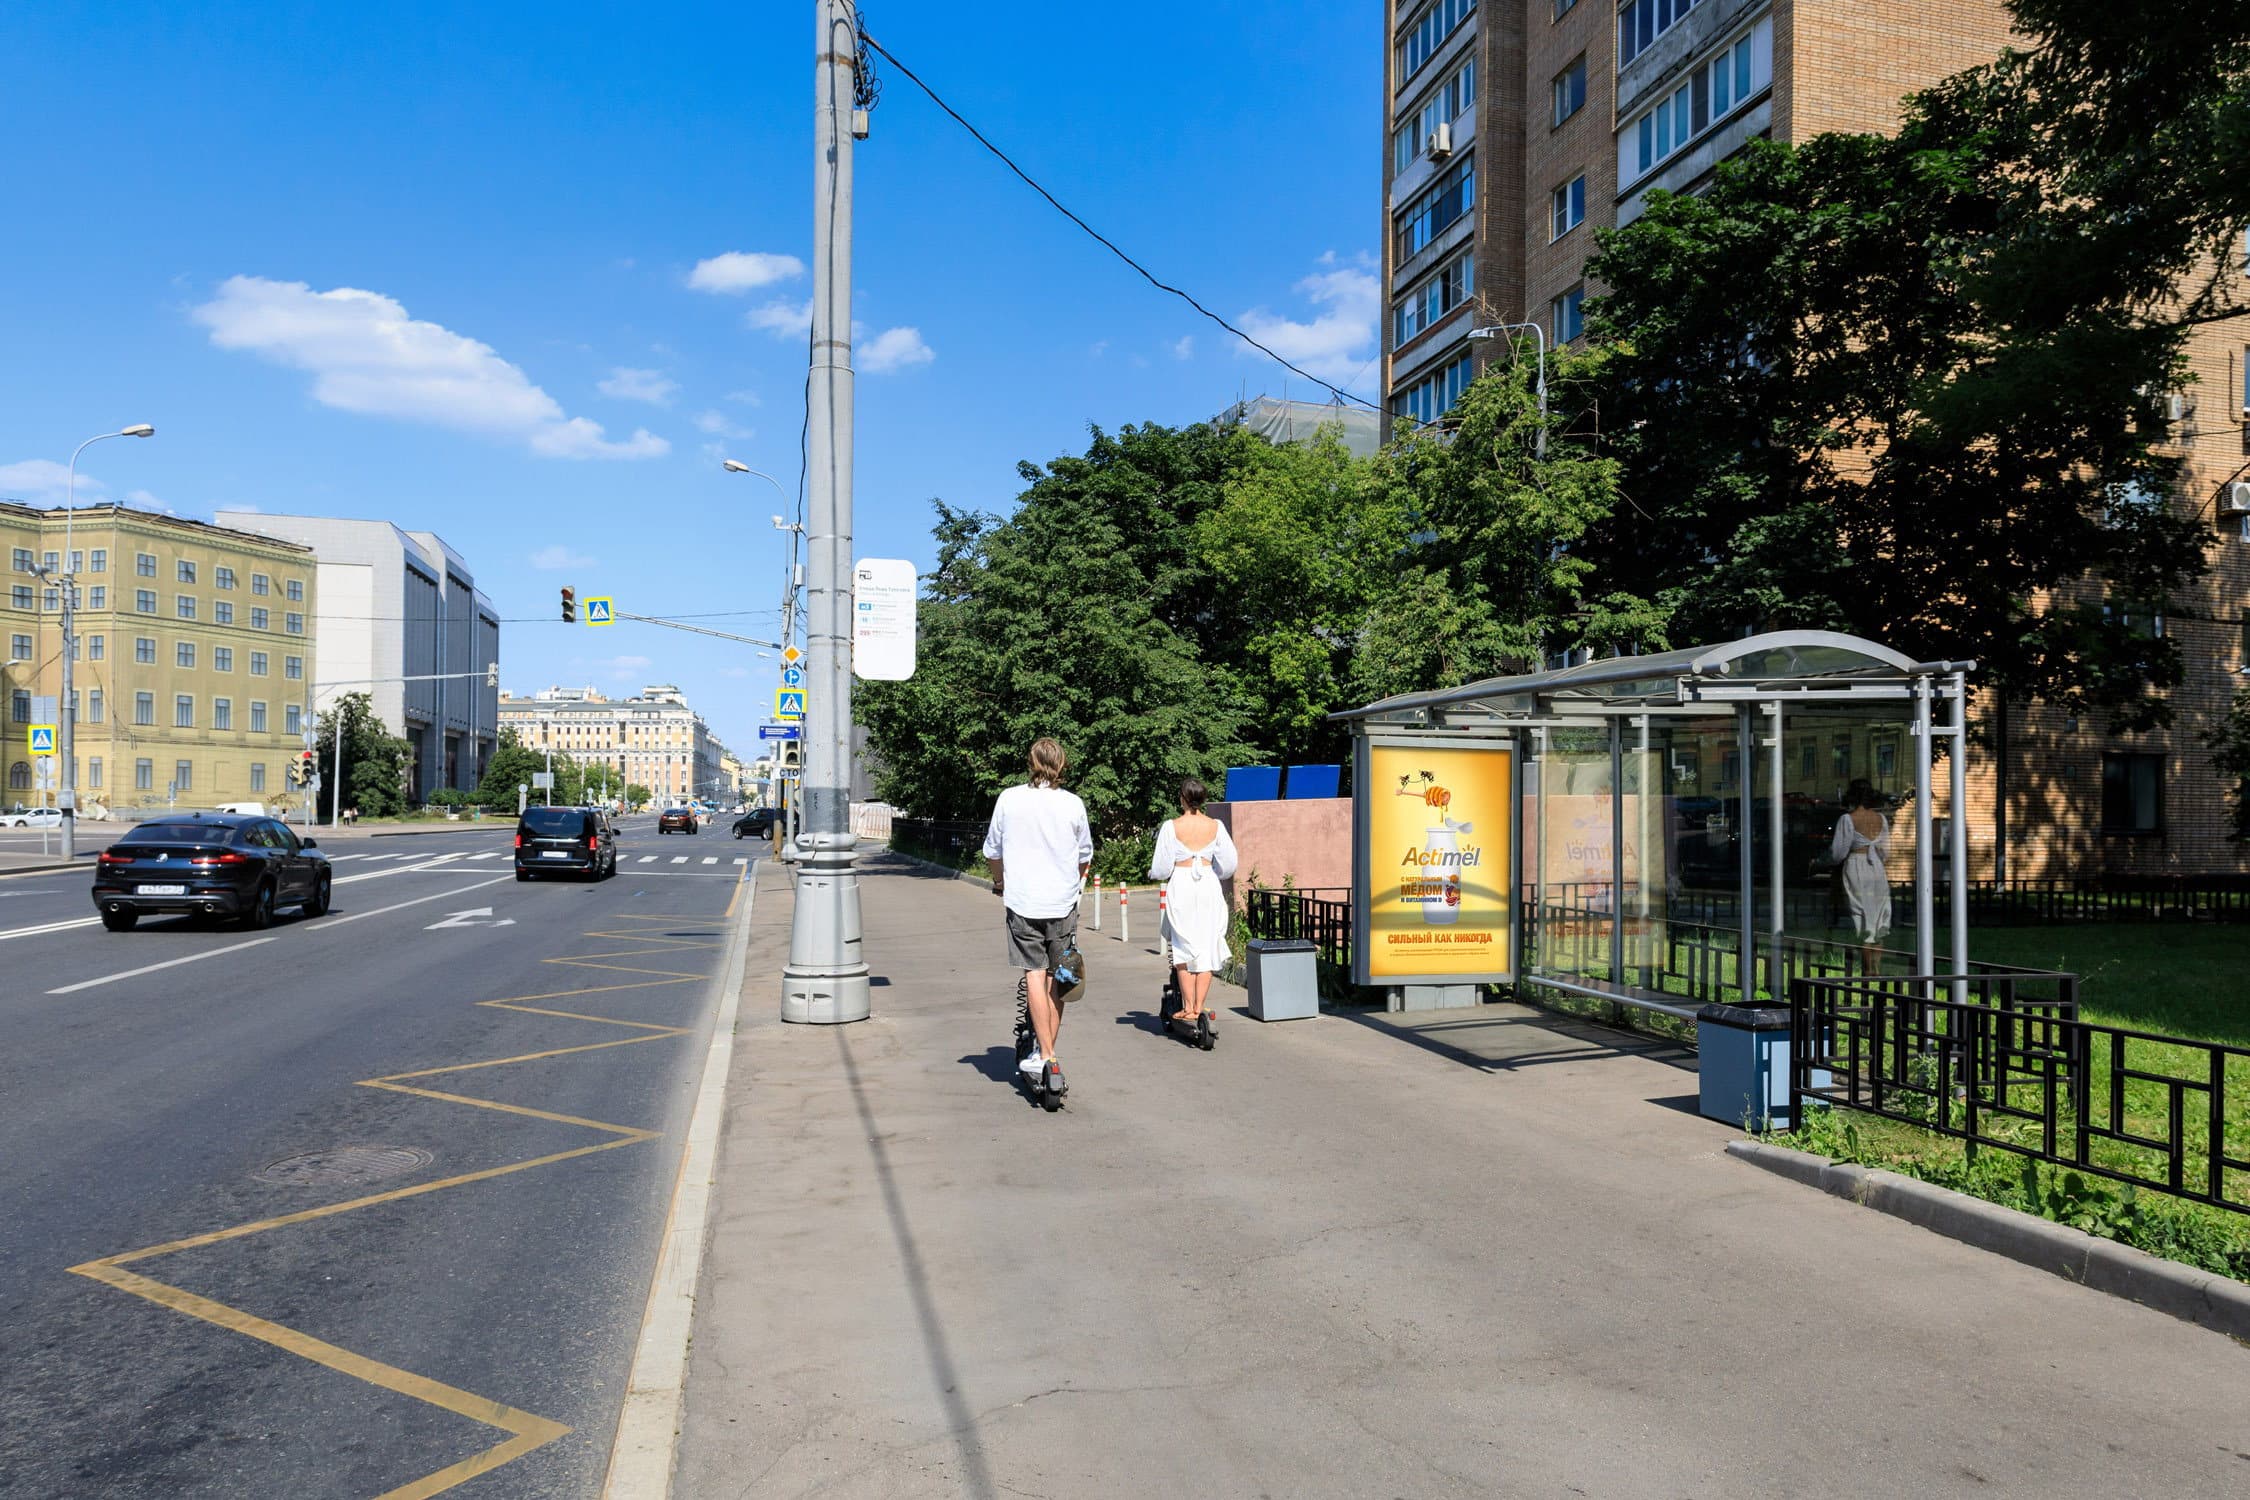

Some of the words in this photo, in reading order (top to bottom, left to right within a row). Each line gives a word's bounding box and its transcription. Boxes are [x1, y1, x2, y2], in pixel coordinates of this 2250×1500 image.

[780, 769, 799, 777] СТО
[1401, 846, 1480, 866] Actimel
[1400, 882, 1442, 897] МЁДОМ
[1388, 931, 1432, 944] СИЛЬНЫЙ
[1434, 933, 1453, 944] КАК
[1454, 933, 1493, 944] НИКОГДА
